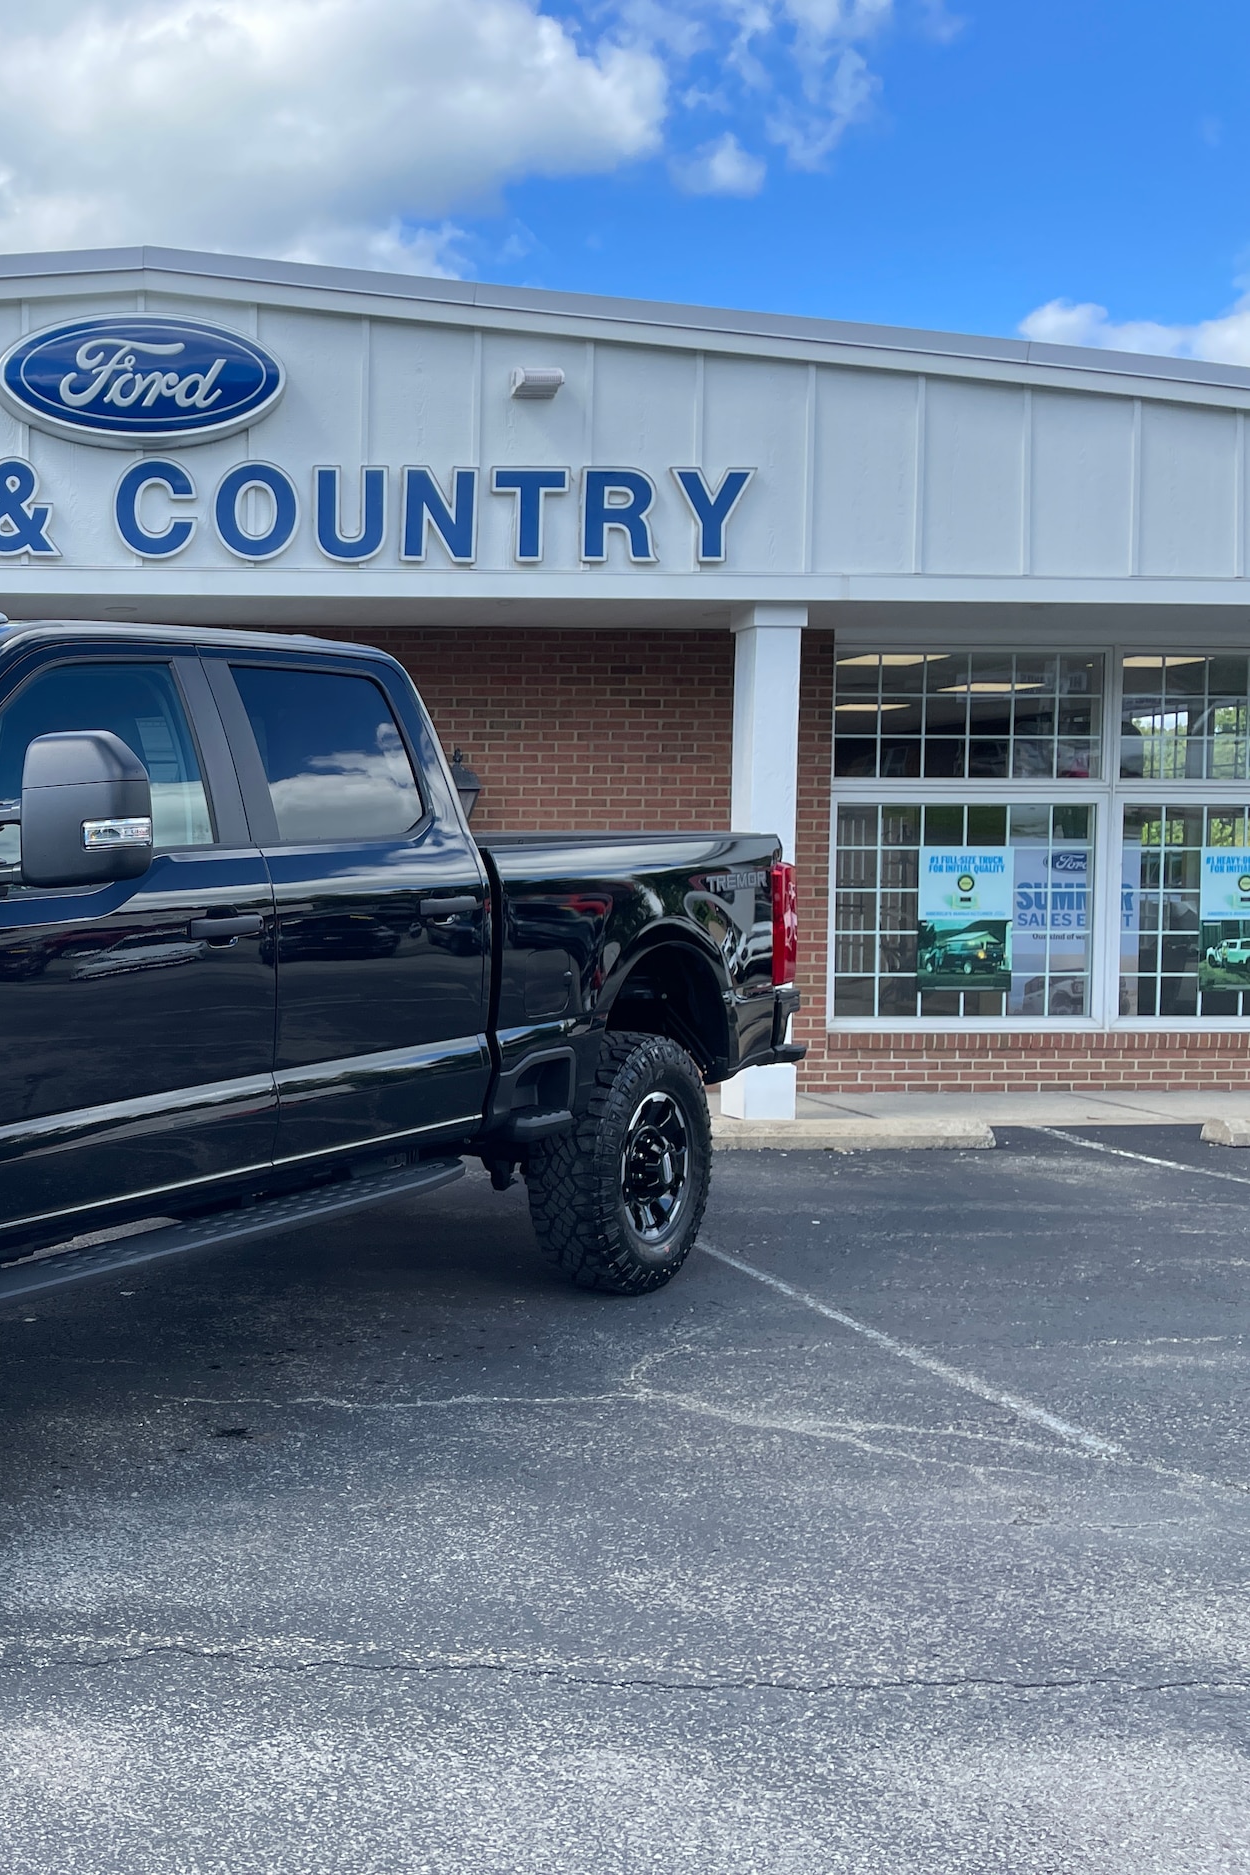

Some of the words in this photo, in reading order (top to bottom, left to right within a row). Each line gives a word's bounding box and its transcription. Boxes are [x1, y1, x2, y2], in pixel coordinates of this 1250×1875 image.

[59, 338, 227, 408] Ford
[114, 456, 758, 562] COUNTRY
[929, 864, 943, 873] FOR
[946, 864, 971, 873] INITIAL
[974, 864, 1005, 874] QUALITY
[979, 856, 1003, 864] TRUCK
[706, 871, 768, 893] TREMOR
[1016, 882, 1134, 911] SUMR
[1018, 913, 1072, 927] SALES
